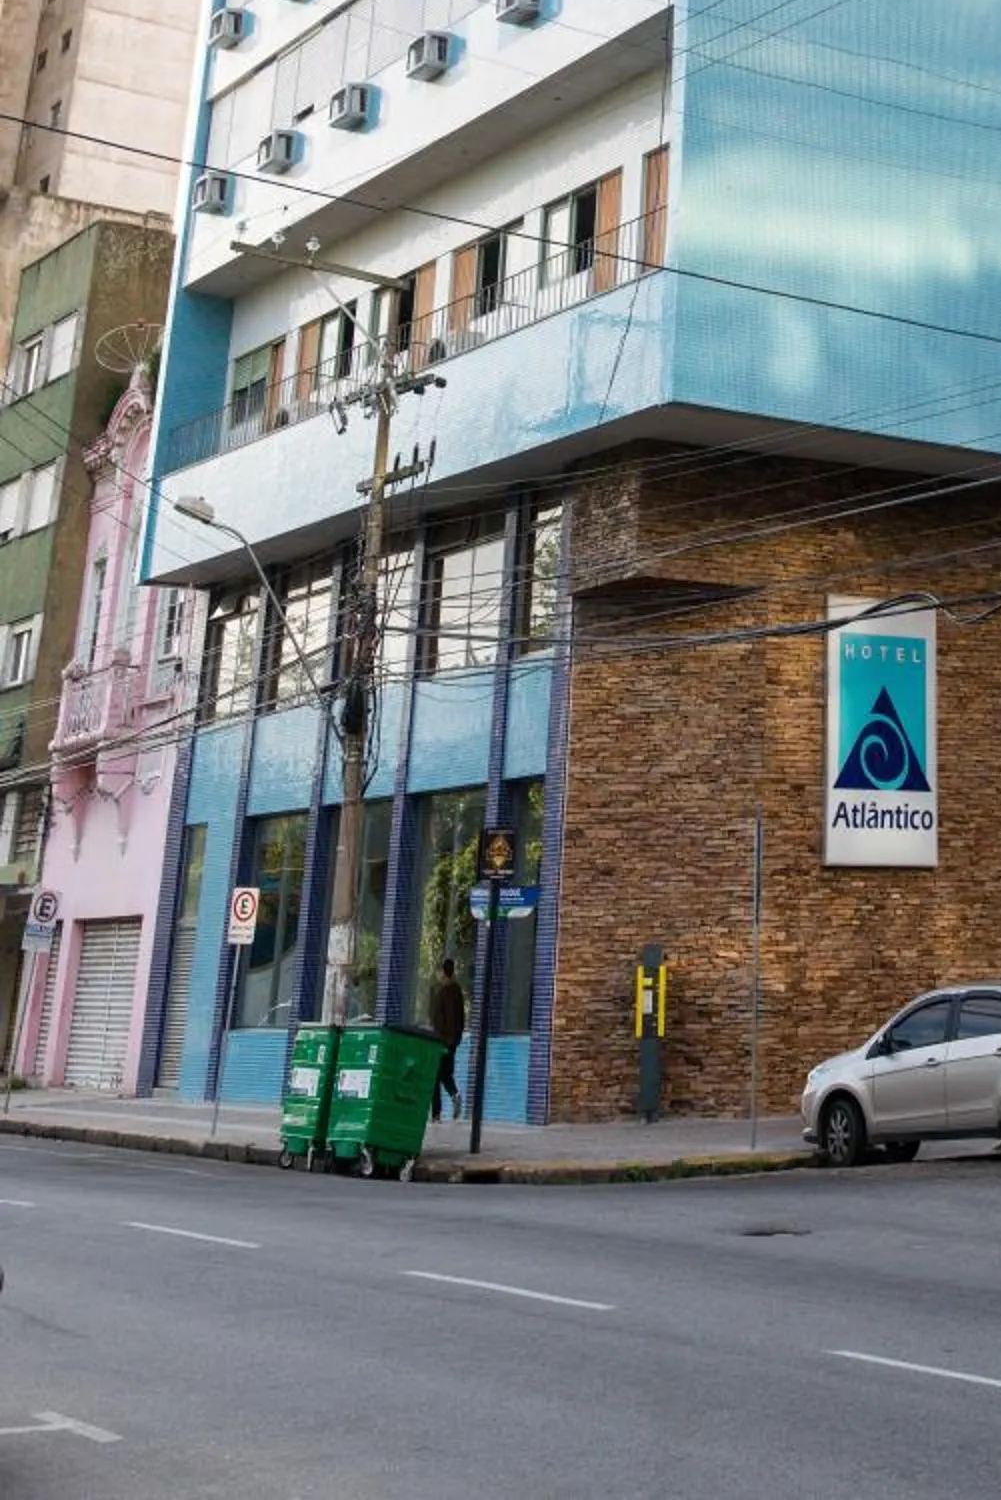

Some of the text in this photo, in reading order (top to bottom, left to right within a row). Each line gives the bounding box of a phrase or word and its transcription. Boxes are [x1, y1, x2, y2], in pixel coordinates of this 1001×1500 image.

[844, 643, 921, 663] HOTEL
[832, 802, 933, 830] Atlântico
[40, 897, 52, 916] E
